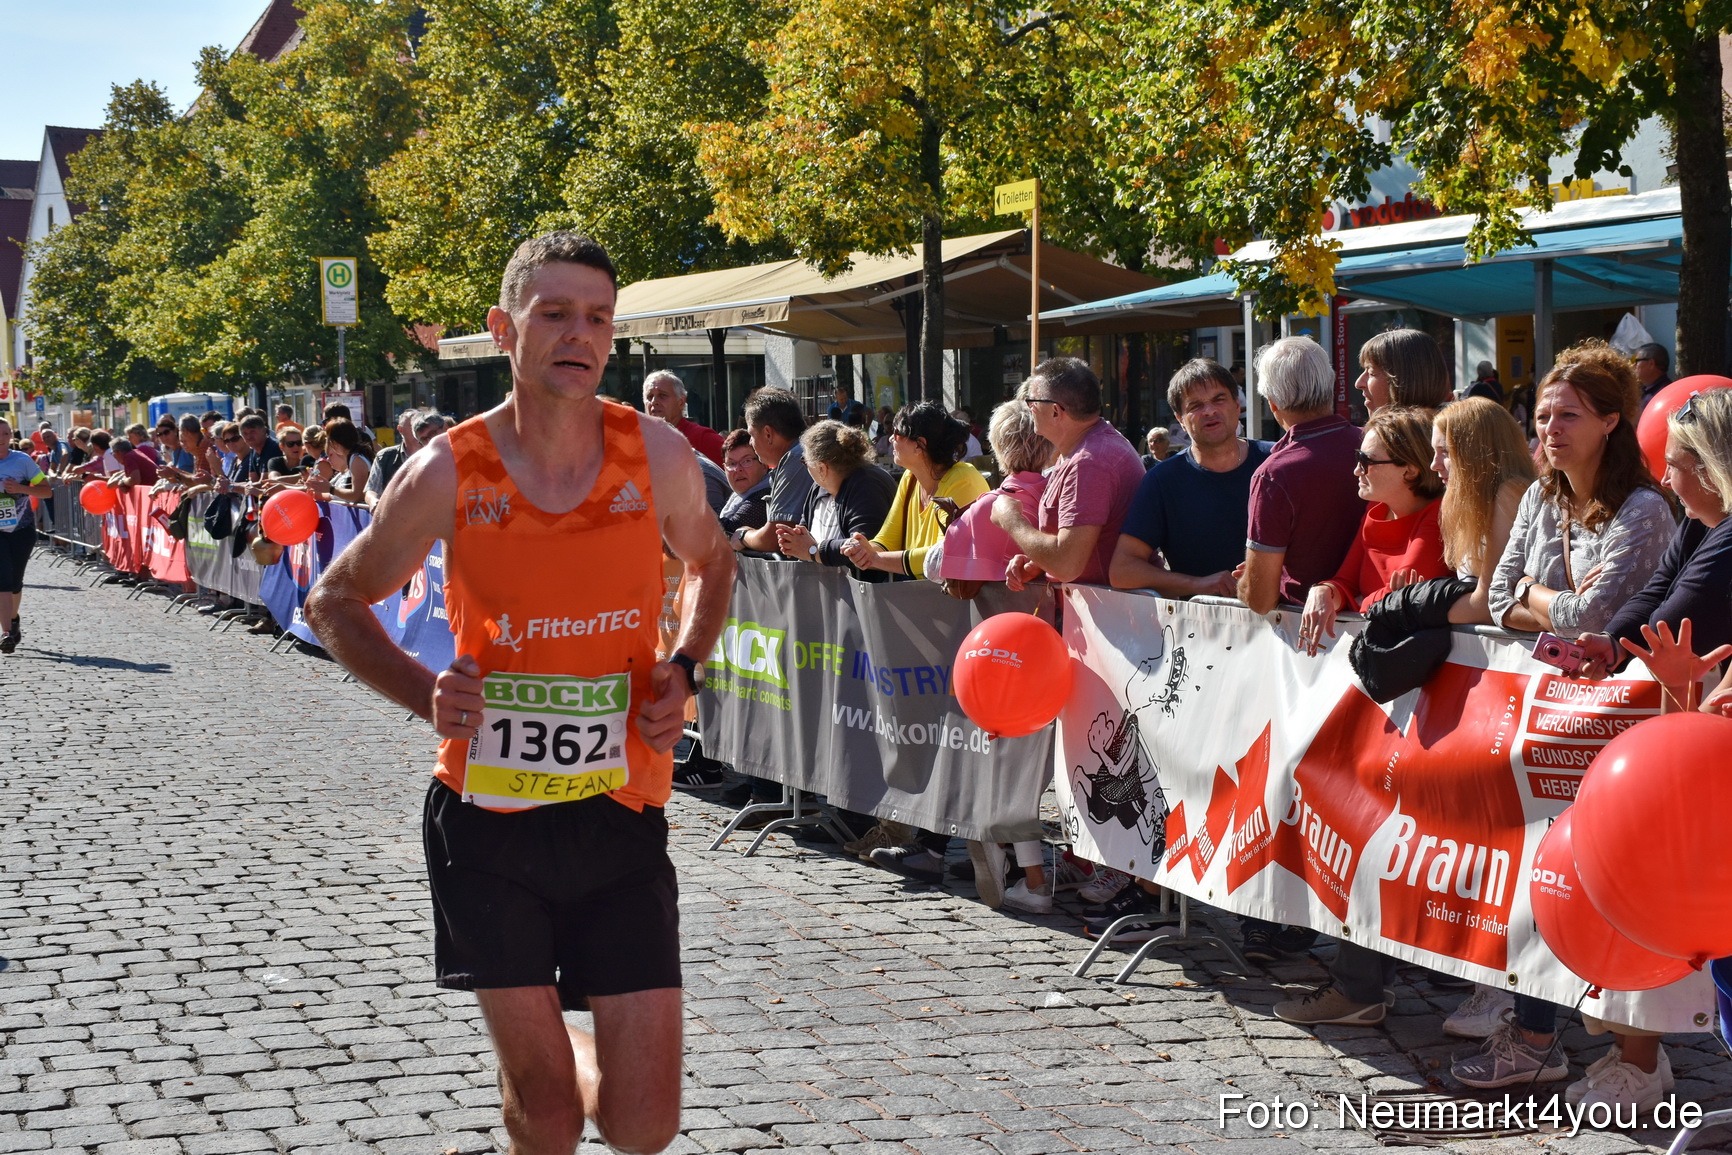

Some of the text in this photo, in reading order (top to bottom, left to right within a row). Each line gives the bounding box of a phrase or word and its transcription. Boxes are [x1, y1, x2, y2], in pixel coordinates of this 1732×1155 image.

[1002, 190, 1033, 206] Toiletten
[1348, 191, 1447, 229] vodafon
[1337, 314, 1346, 402] Business Store
[609, 499, 648, 514] adidas
[526, 608, 641, 640] FitterTEC
[991, 658, 1021, 669] energie
[484, 680, 614, 711] BOCK
[1546, 680, 1632, 704] BINDESTRICKE
[1490, 695, 1517, 756] Seit 1929
[1535, 712, 1641, 736] VERZURRSYST
[491, 718, 609, 766] 1362
[1531, 746, 1598, 765] RUNDSC
[508, 772, 613, 798] STEFAN
[1383, 751, 1400, 791] Seit 1929
[1539, 778, 1580, 798] HEBE
[1281, 779, 1353, 882] Braun
[1380, 813, 1510, 907] Braun
[1306, 850, 1351, 903] Sicher ist sicher
[1540, 884, 1572, 901] energie
[1426, 899, 1463, 924] Sicher
[1465, 910, 1481, 929] ist
[1481, 915, 1509, 937] sicher
